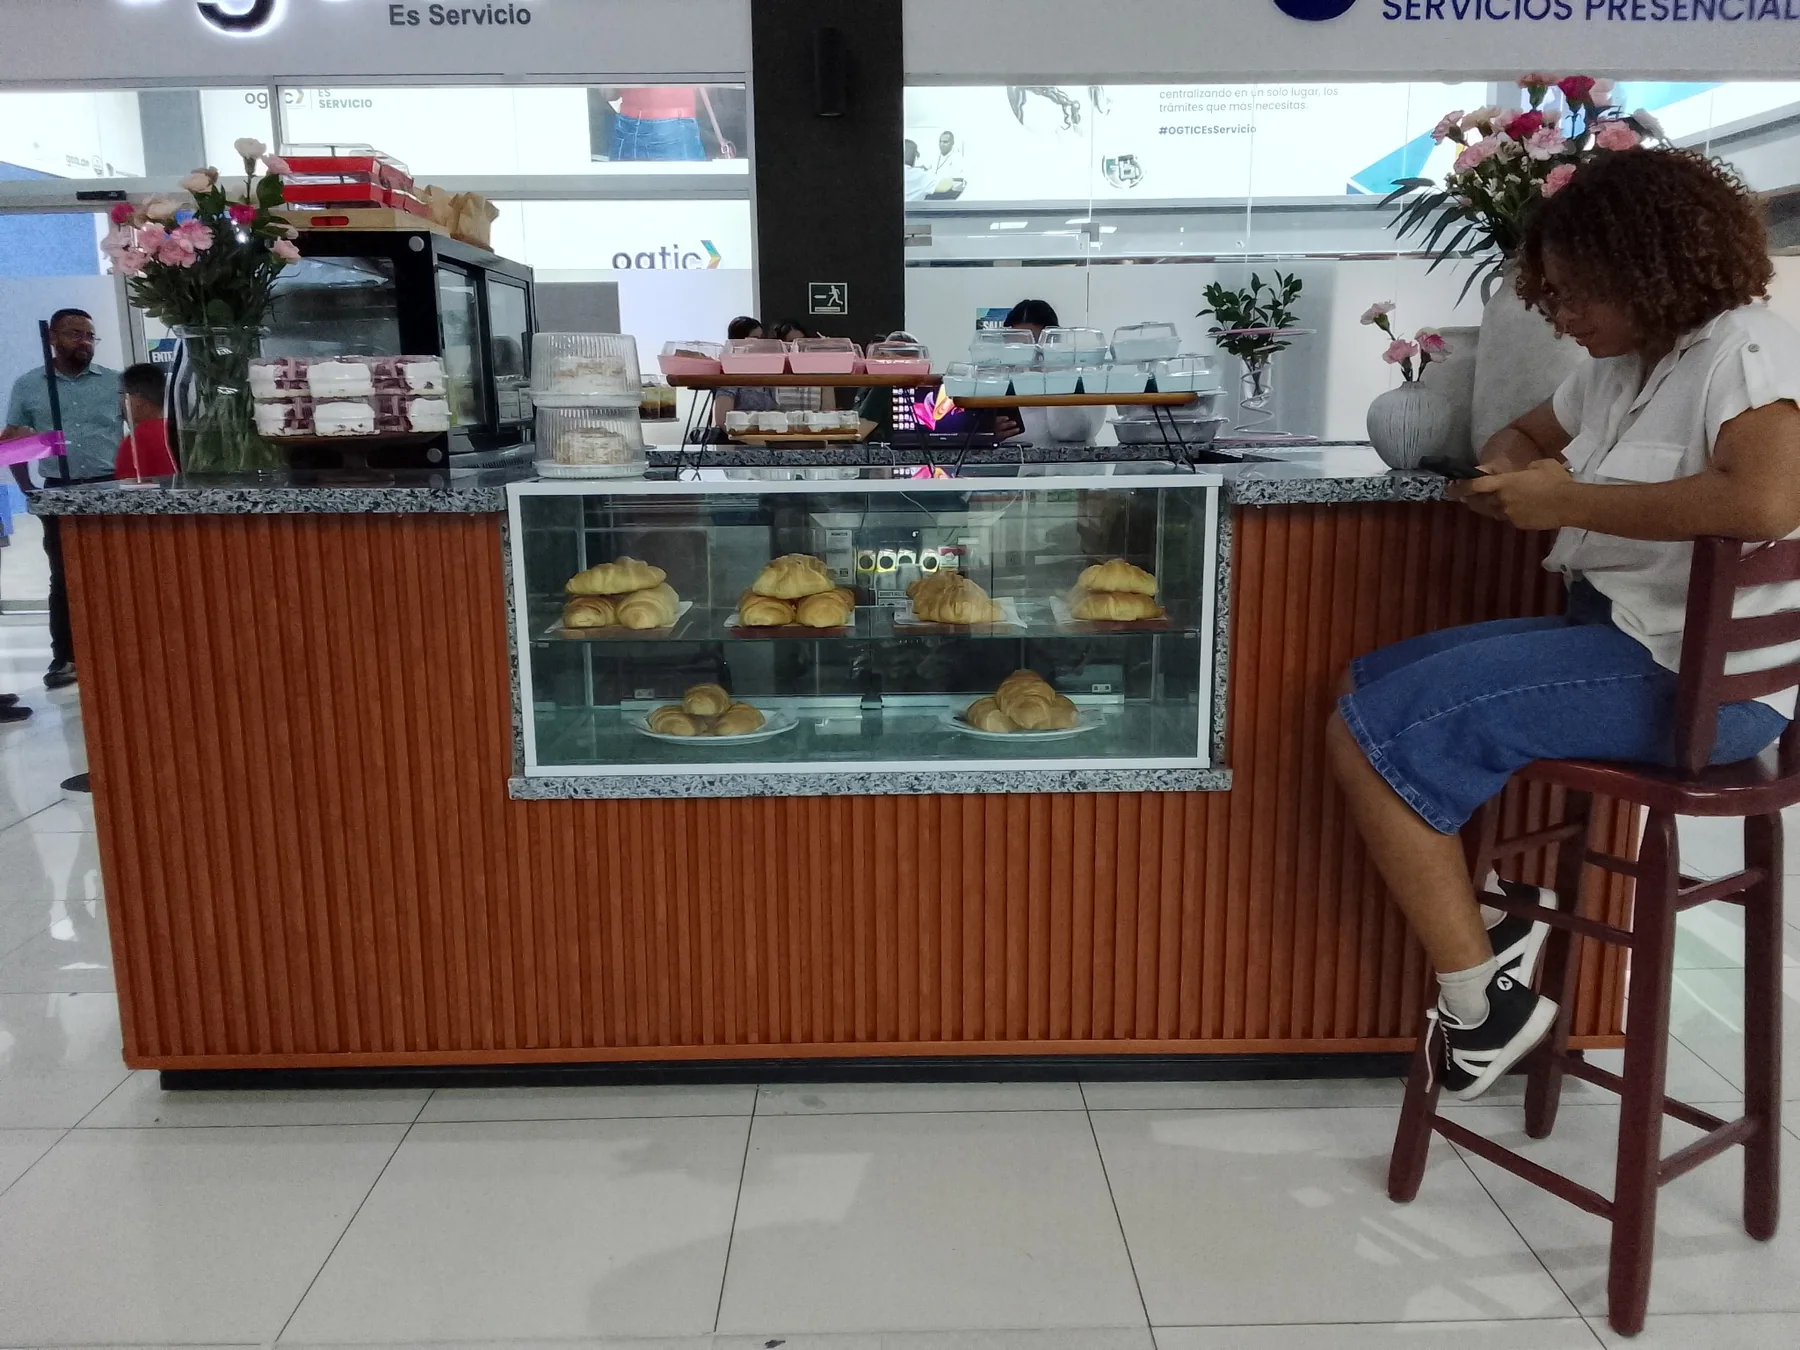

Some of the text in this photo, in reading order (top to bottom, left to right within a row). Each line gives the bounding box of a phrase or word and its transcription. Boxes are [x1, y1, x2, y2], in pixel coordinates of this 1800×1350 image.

[389, 3, 531, 26] Es Servicio
[1382, 0, 1800, 21] SERVICIOS PRESENCIAL
[318, 88, 331, 97] ES
[1159, 88, 1232, 99] centralizando
[1234, 89, 1248, 98] en
[1251, 88, 1266, 97] un
[1267, 87, 1288, 97] solo
[1323, 87, 1339, 96] los
[244, 91, 295, 109] ogc
[319, 99, 373, 109] SERVICIO
[1159, 102, 1204, 113] trámites
[1206, 103, 1226, 114] que
[1255, 100, 1309, 111] necesitas.
[1158, 124, 1257, 135] #OGTICEsServicio
